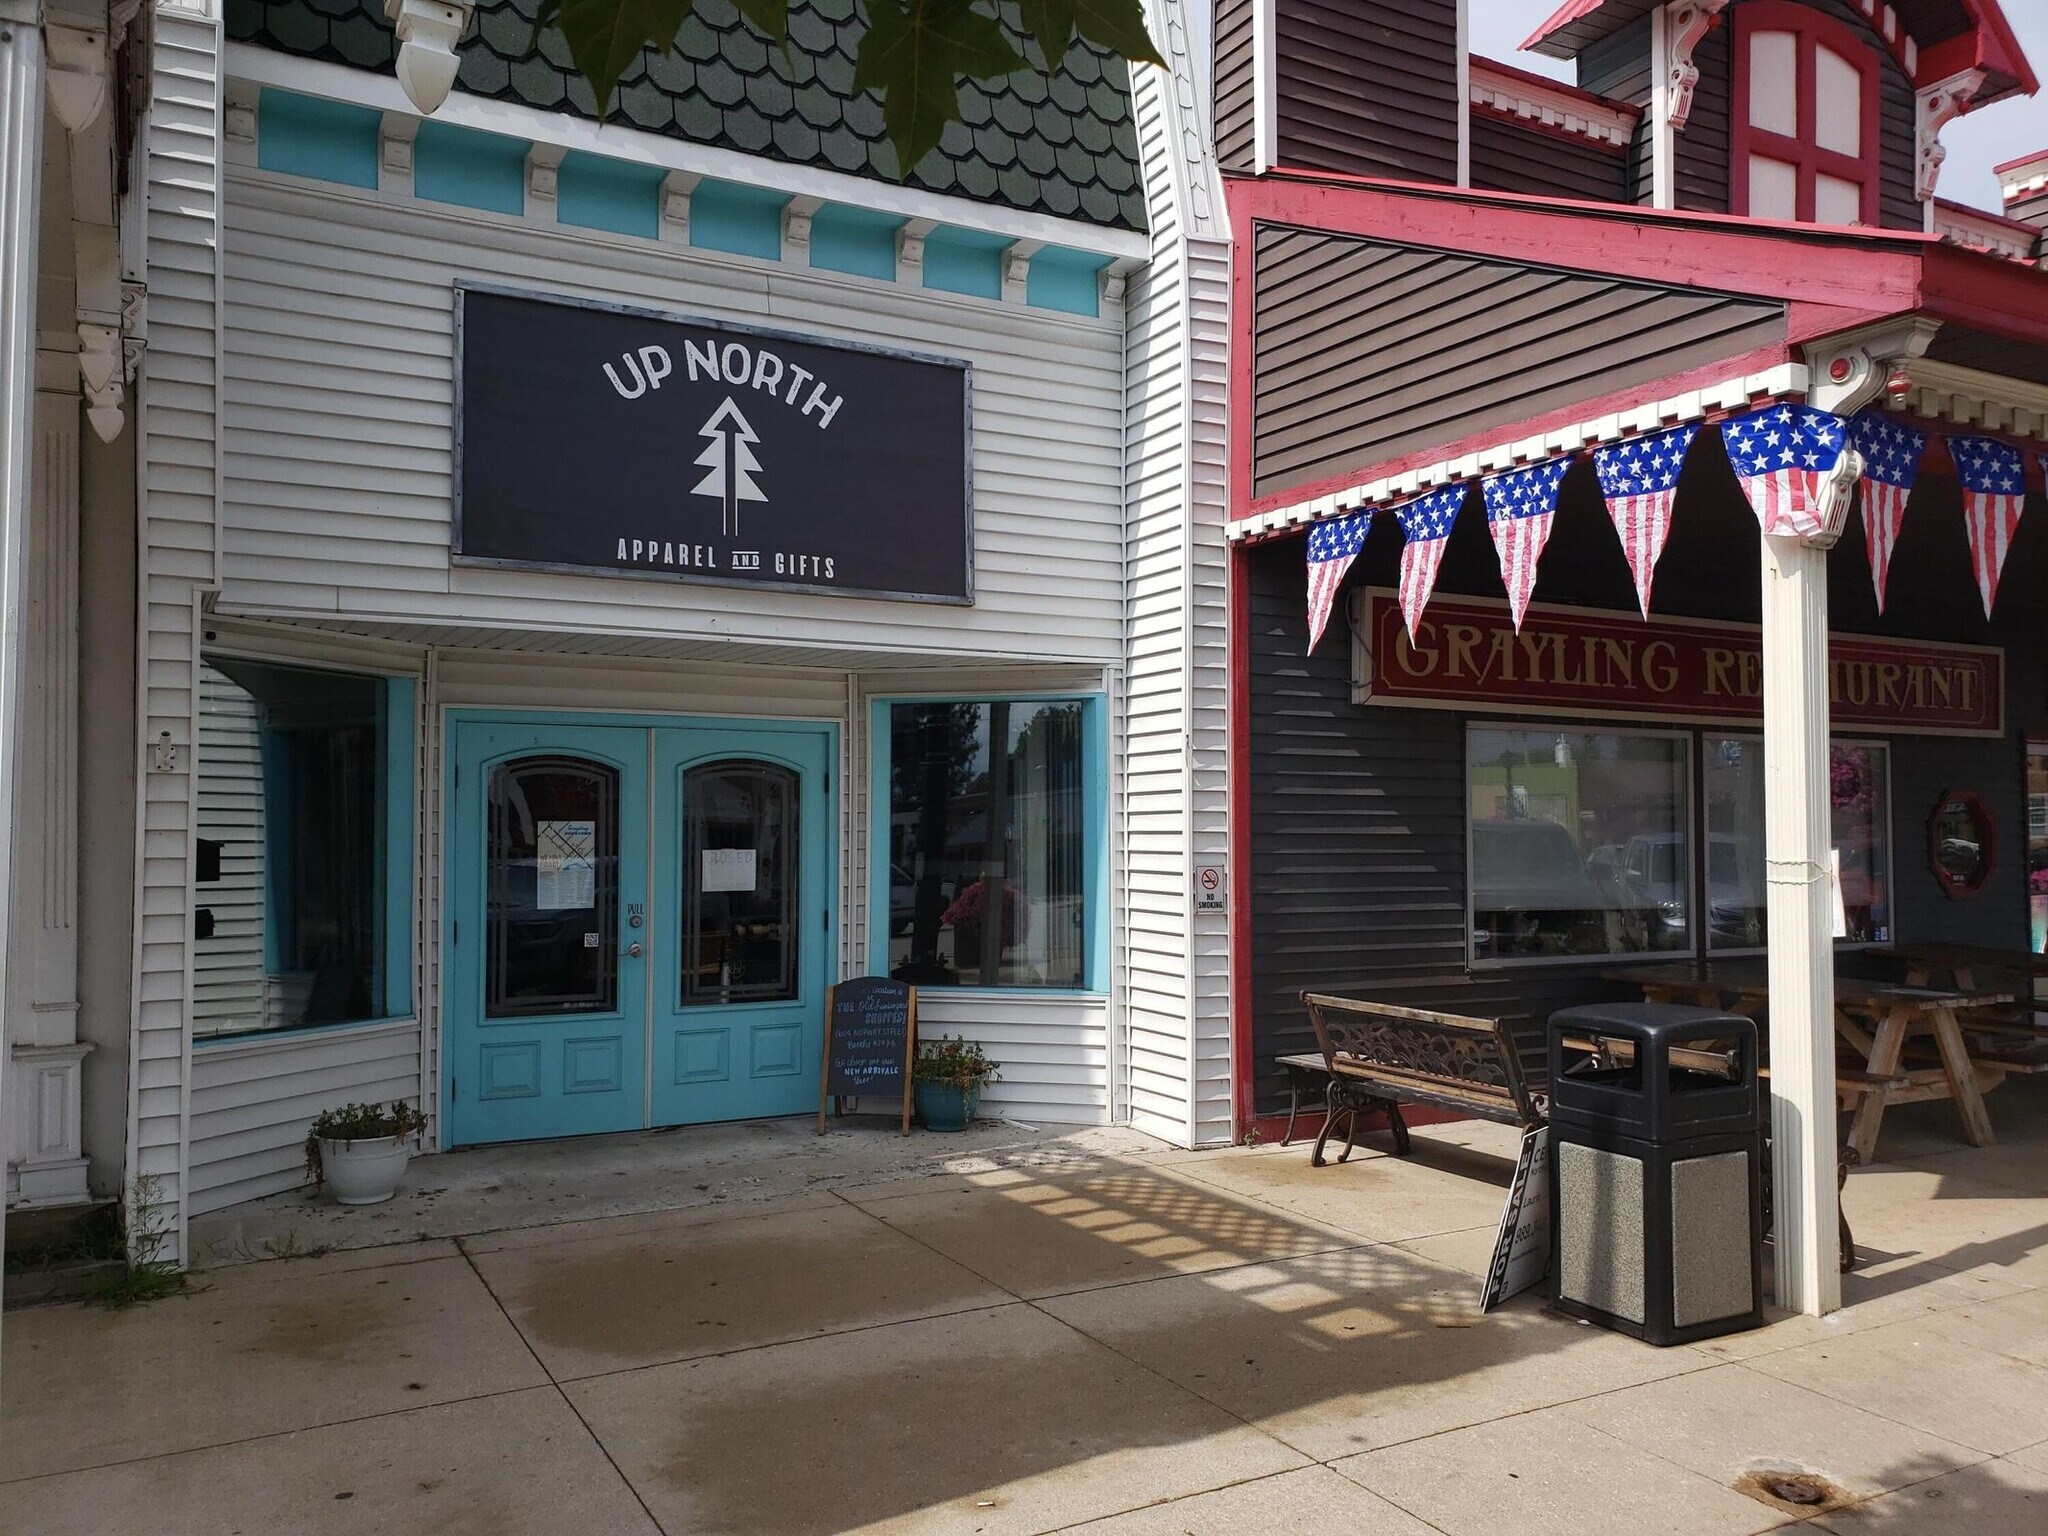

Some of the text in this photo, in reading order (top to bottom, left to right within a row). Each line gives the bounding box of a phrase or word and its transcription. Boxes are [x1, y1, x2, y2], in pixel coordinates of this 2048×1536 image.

[602, 338, 844, 430] UP NORTH
[617, 537, 835, 579] APPAREL AND GIFTS
[1395, 619, 1978, 713] GRAYLING REURANT
[627, 903, 645, 916] PULL
[1198, 901, 1223, 909] SMOKING
[1206, 893, 1215, 901] NO
[845, 1066, 901, 1076] NEW ARRIVALS
[1490, 1234, 1513, 1295] FOR
[1507, 1151, 1532, 1228] SALE
